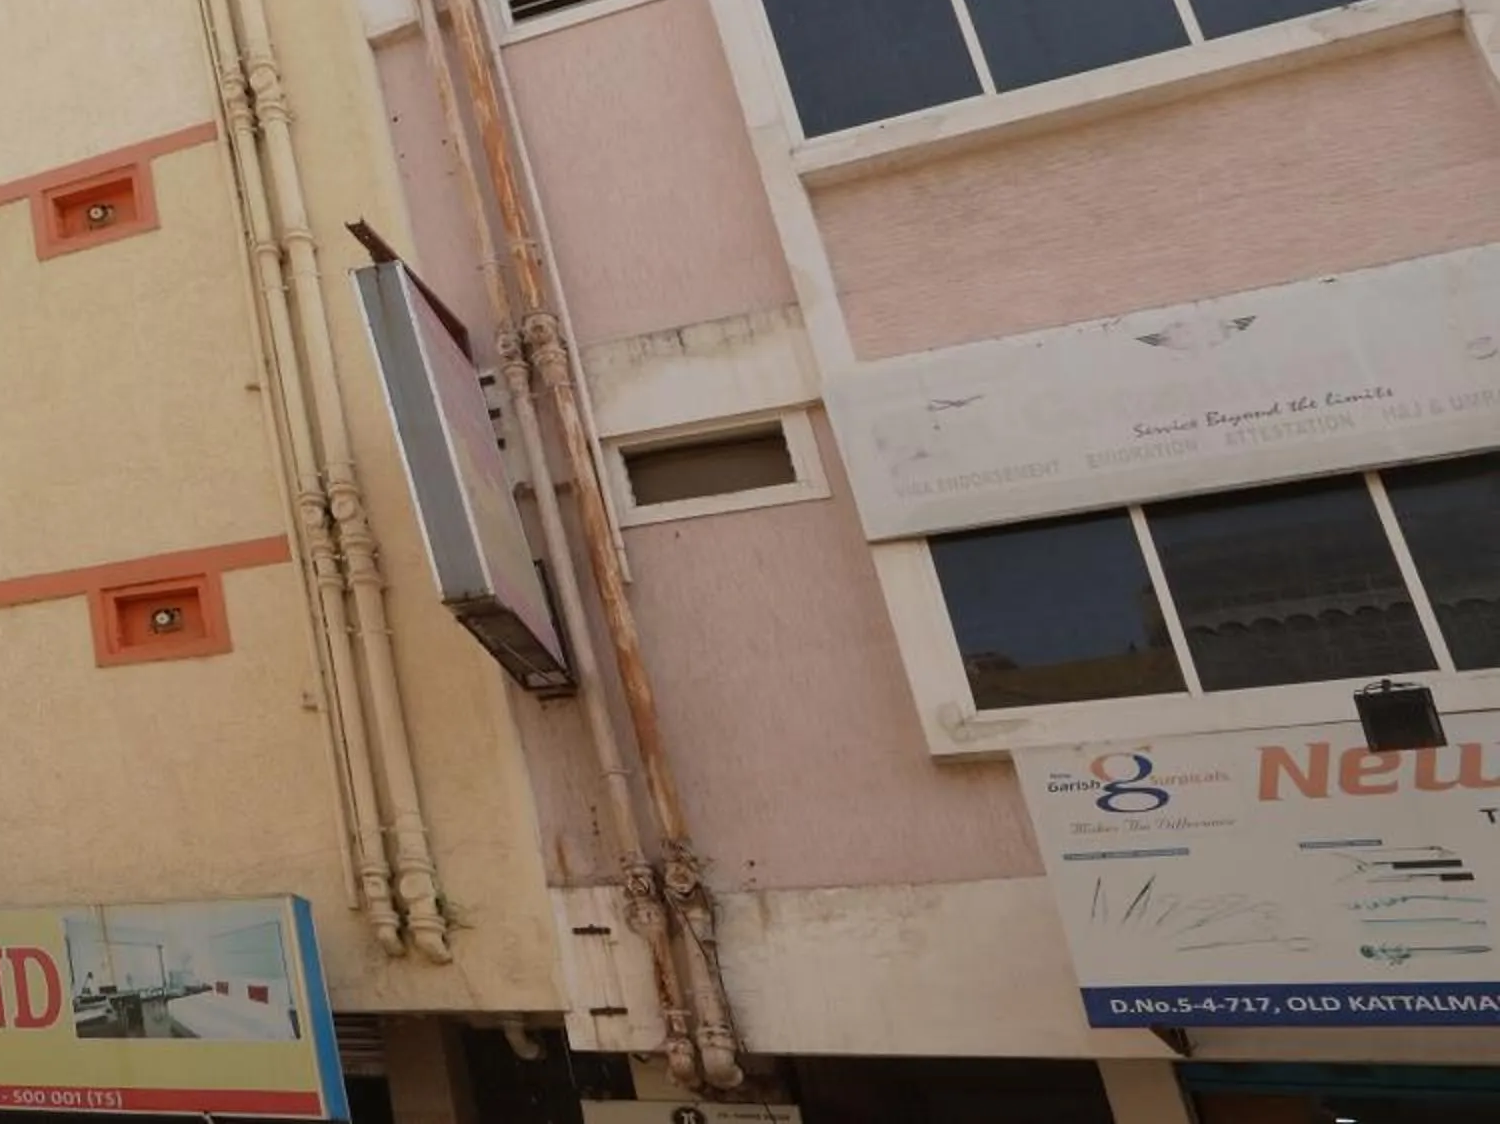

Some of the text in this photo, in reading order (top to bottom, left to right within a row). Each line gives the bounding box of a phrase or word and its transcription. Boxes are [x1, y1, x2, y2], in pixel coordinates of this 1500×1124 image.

[1133, 419, 1198, 438] Service
[1206, 402, 1282, 426] Beyond
[1287, 397, 1317, 413] the
[1225, 411, 1356, 448] ATTESTATION
[1256, 742, 1500, 802] New
[1110, 994, 1500, 1015] D.No.5-4-717, OLD KATTALMA
[12, 1089, 46, 1104] 500
[50, 1090, 82, 1105] 001
[88, 1090, 123, 1108] (TS)
